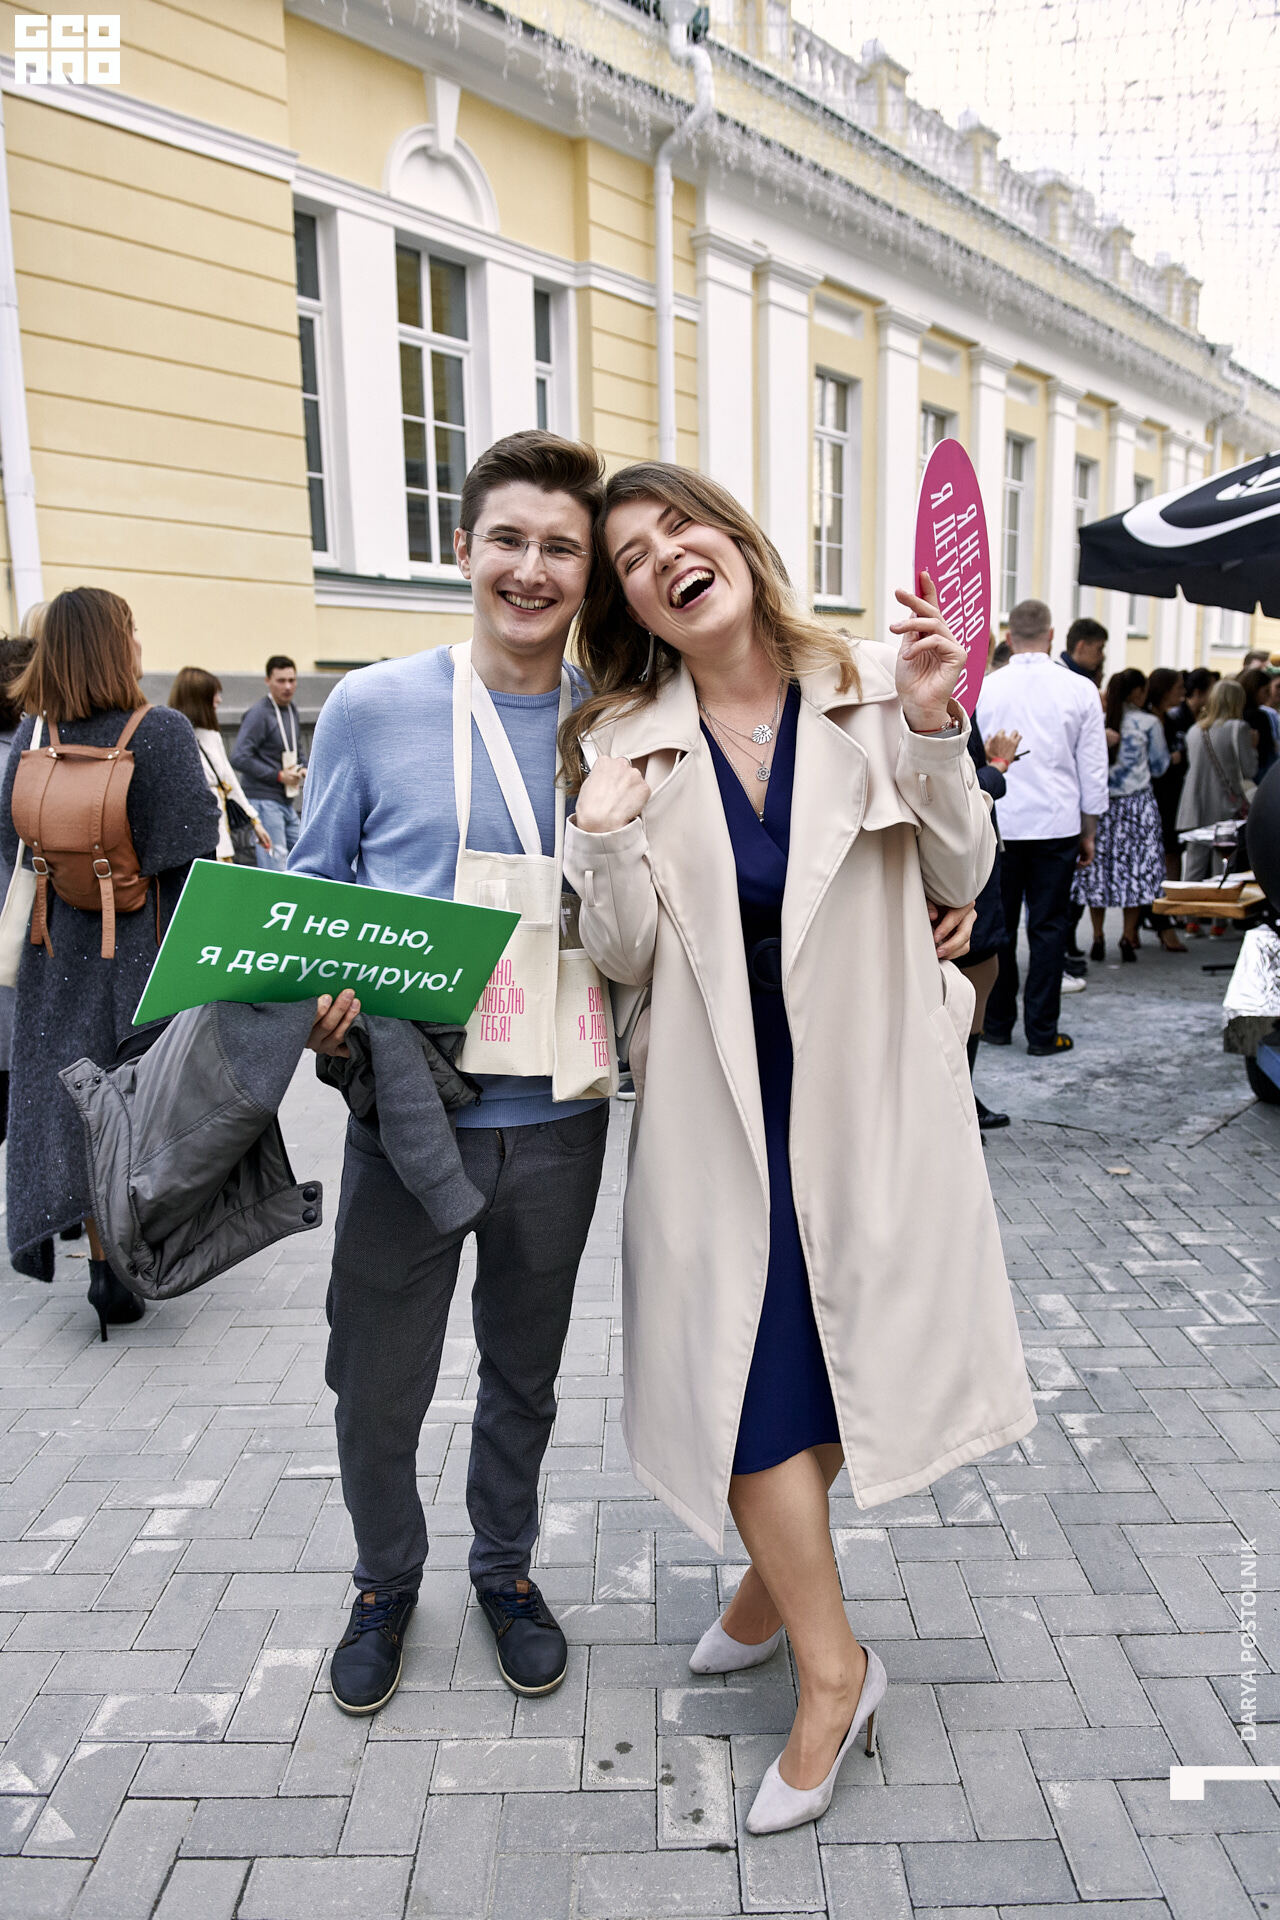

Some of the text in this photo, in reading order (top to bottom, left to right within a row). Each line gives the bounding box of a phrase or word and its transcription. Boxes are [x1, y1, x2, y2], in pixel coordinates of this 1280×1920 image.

[930, 481, 954, 510] Я
[956, 503, 985, 654] Я НЕ ПЬЮ,
[262, 901, 435, 955] Я не пью,
[196, 945, 463, 994] я дегустирую!
[488, 959, 515, 987] НО,
[480, 986, 525, 1015] ЛЮБЛЮ
[480, 1014, 512, 1043] ТЕБЯ!
[578, 1014, 586, 1041] Я
